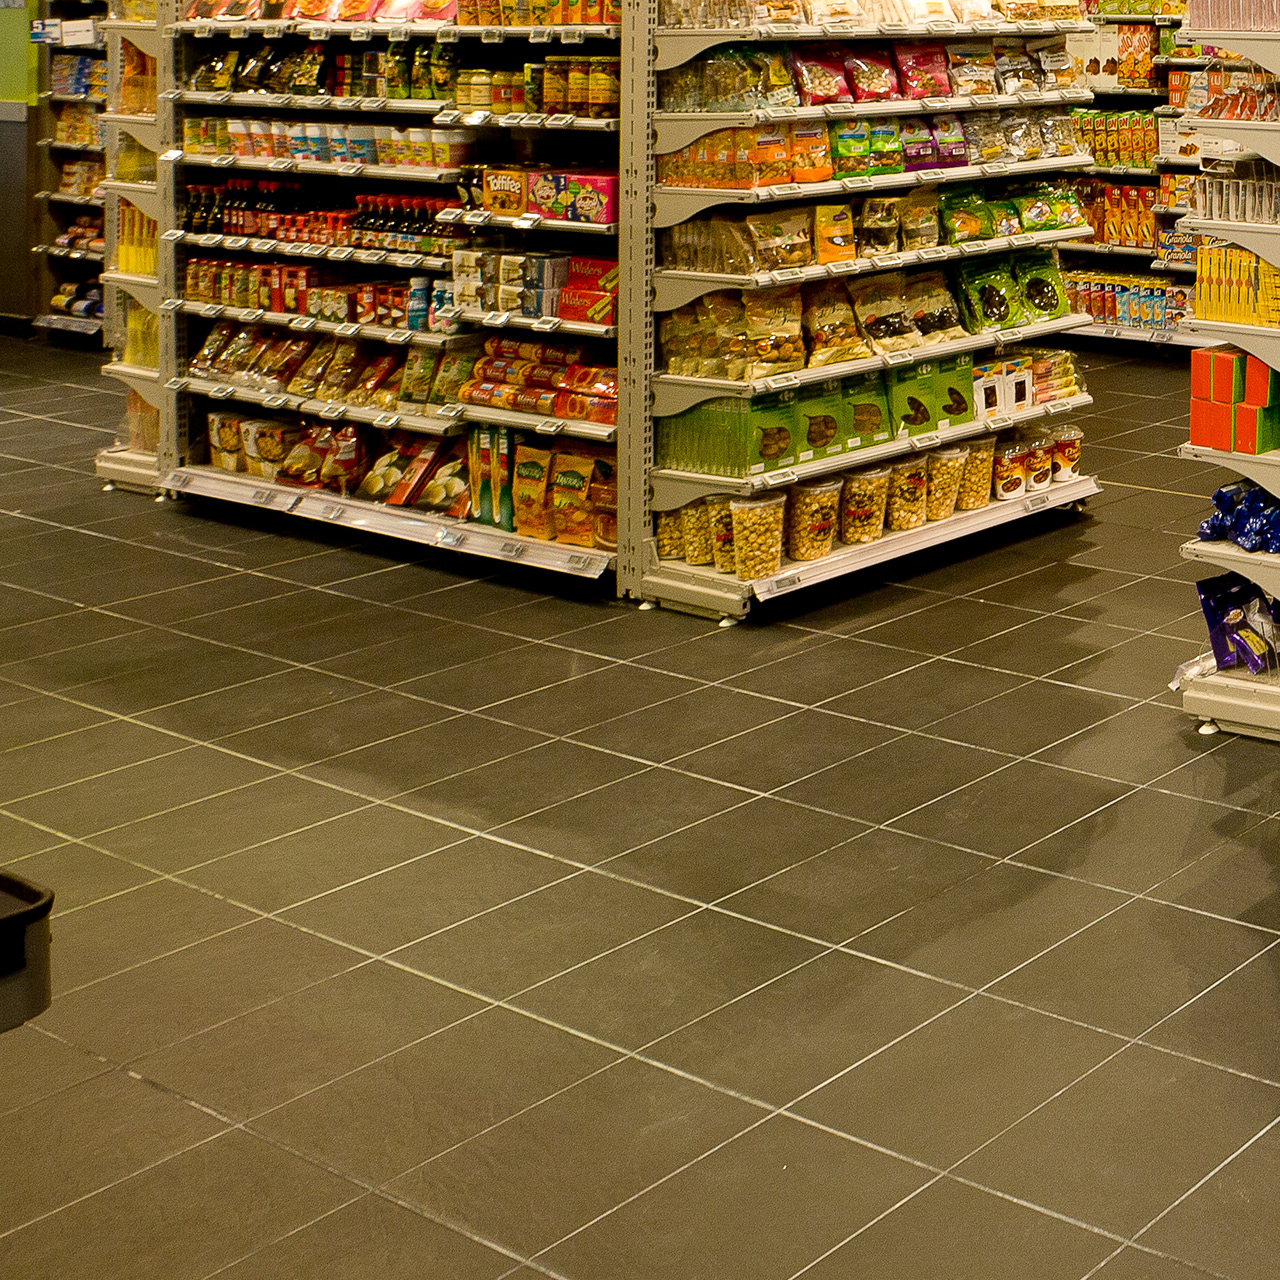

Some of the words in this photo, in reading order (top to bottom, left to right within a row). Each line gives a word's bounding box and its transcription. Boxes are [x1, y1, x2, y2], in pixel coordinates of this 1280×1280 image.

[487, 175, 521, 193] Toffifee
[1165, 232, 1193, 246] Granola
[1164, 250, 1192, 263] Granola
